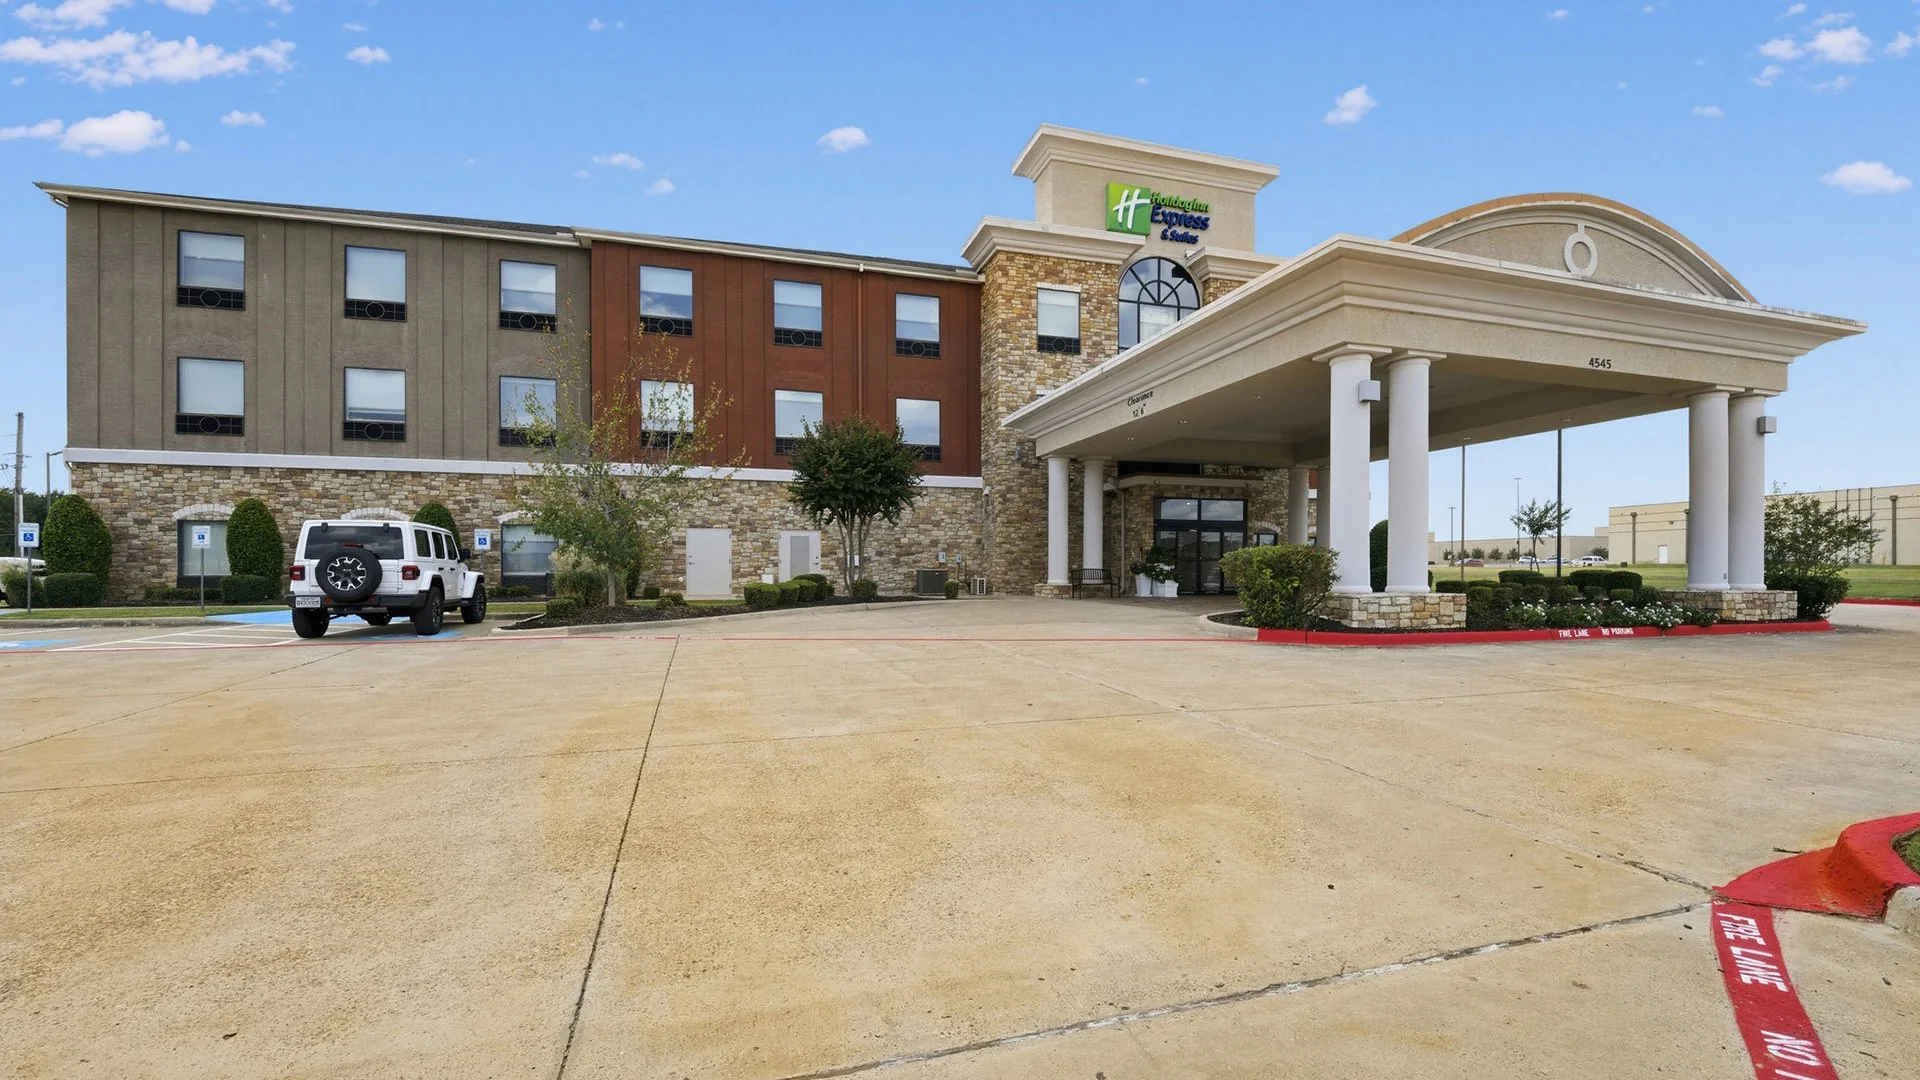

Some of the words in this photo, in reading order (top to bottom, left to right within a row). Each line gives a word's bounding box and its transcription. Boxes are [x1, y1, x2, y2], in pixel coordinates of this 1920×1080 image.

[1151, 205, 1210, 231] Express
[1160, 228, 1169, 241] &
[1169, 230, 1199, 245] Suites
[1588, 357, 1612, 369] 4545
[1127, 391, 1153, 406] Clearance
[1573, 628, 1590, 637] LANE
[1717, 912, 1767, 946] FIRE
[1730, 946, 1789, 993] LANE
[1760, 1030, 1822, 1067] NO
